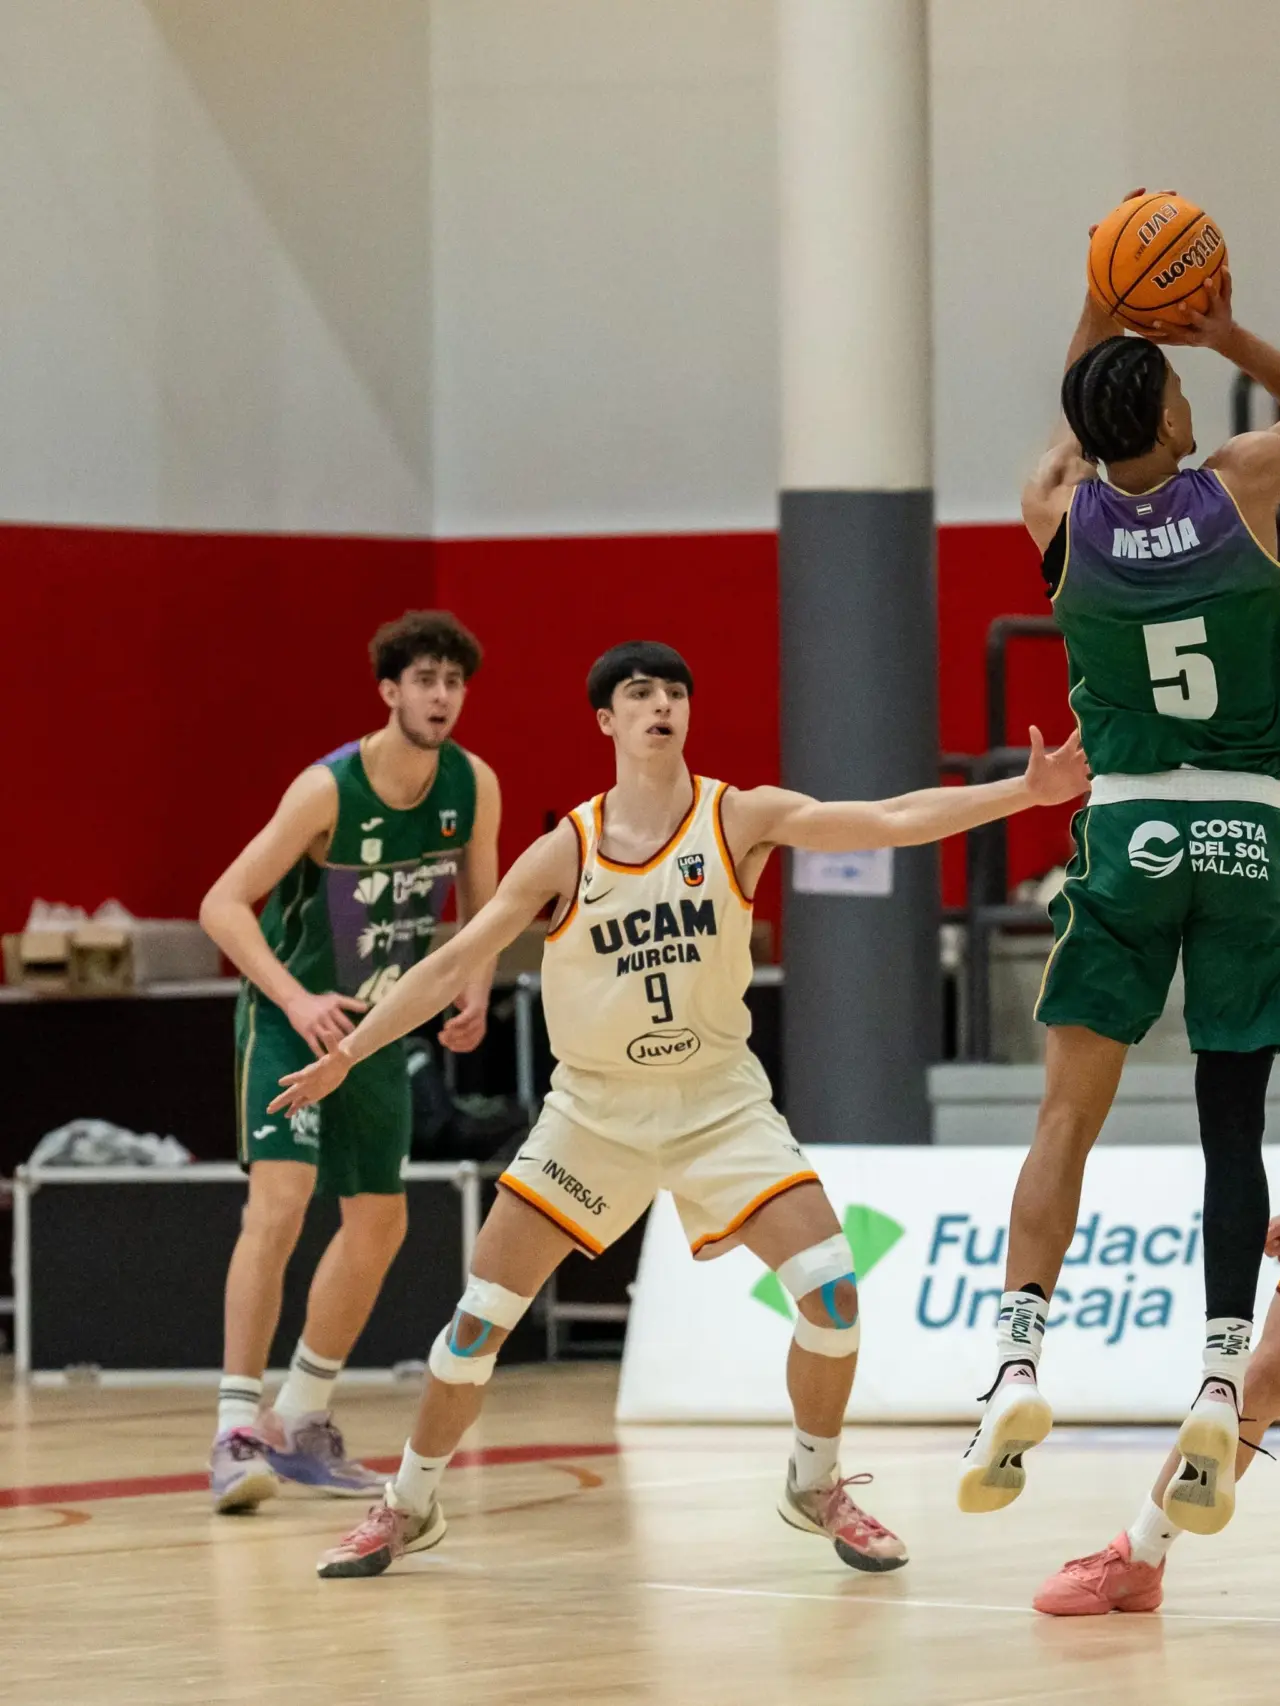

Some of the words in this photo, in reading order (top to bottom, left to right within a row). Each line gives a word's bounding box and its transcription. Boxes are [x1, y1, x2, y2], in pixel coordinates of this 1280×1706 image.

[1137, 203, 1179, 247] EVO
[1150, 223, 1222, 290] Wilson
[1112, 516, 1201, 560] MEJÍA
[1142, 615, 1219, 721] 5
[1189, 840, 1231, 857] DEL
[1234, 842, 1270, 863] SOL
[1190, 819, 1268, 845] COSTA
[680, 855, 702, 866] LIGA
[1191, 856, 1269, 881] MÁLAGA
[589, 898, 717, 954] UCAM
[616, 943, 702, 977] MURCIA
[644, 971, 674, 1025] 9
[636, 1036, 694, 1059] Juver
[541, 1158, 607, 1216] INVERSUS
[927, 1212, 1203, 1267] Fudaci
[915, 1274, 1174, 1346] Uncaja
